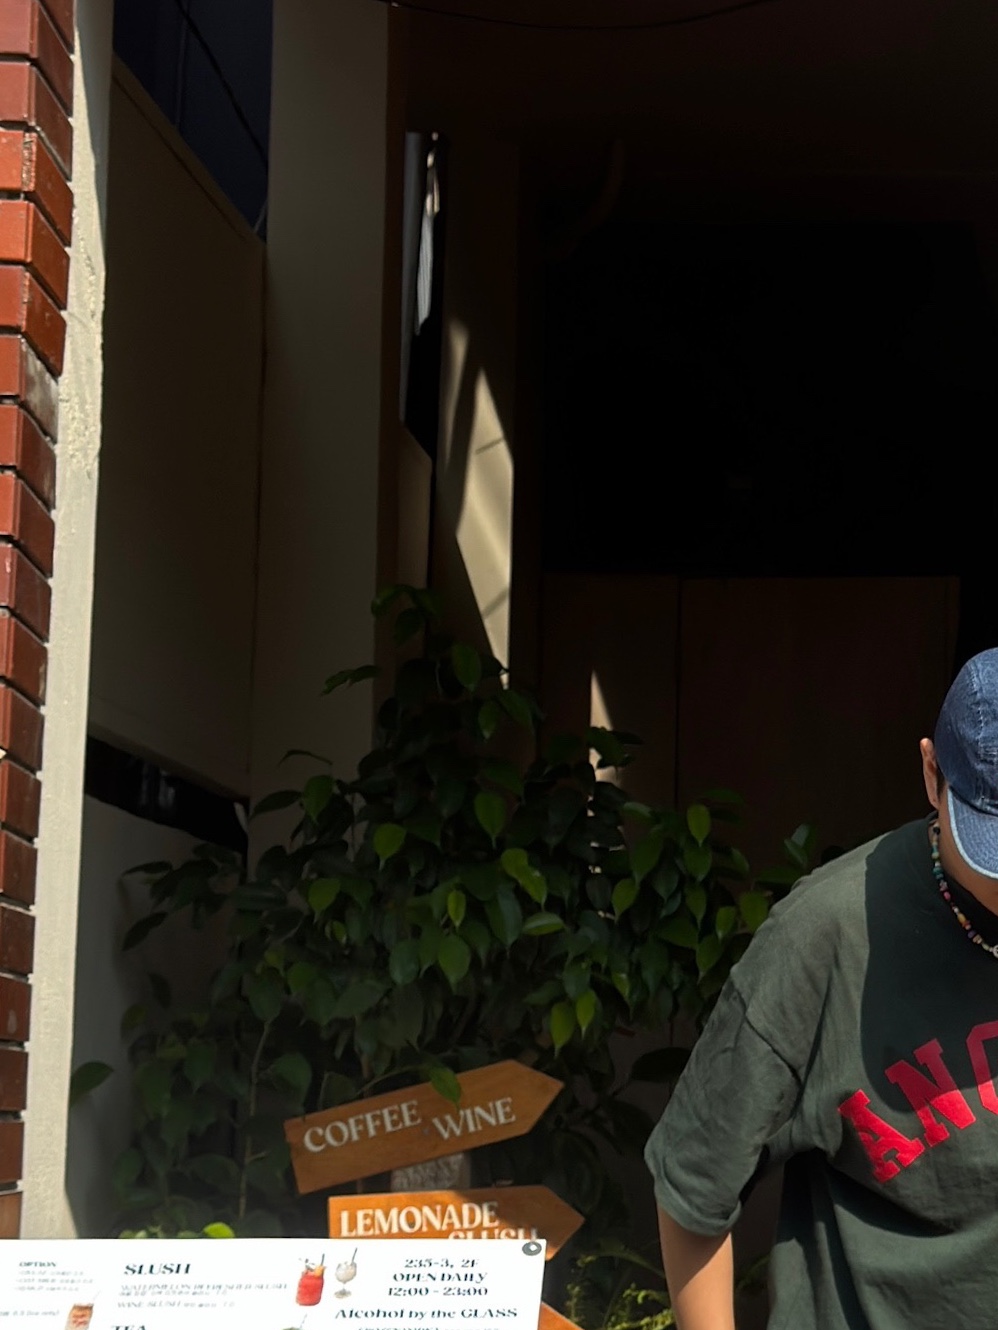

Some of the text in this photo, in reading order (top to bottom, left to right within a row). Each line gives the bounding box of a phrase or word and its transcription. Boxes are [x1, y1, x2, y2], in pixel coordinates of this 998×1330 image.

[303, 1097, 516, 1153] COFFEE WINE
[340, 1202, 500, 1238] LEMONADE
[123, 1263, 192, 1276] SLUSH
[405, 1258, 479, 1269] 235-3, 2F
[393, 1271, 488, 1284] OPEN DAILY
[388, 1286, 430, 1297] 12:00
[443, 1286, 488, 1297] 23:00
[335, 1308, 518, 1321] Alcohol by the GLASS
